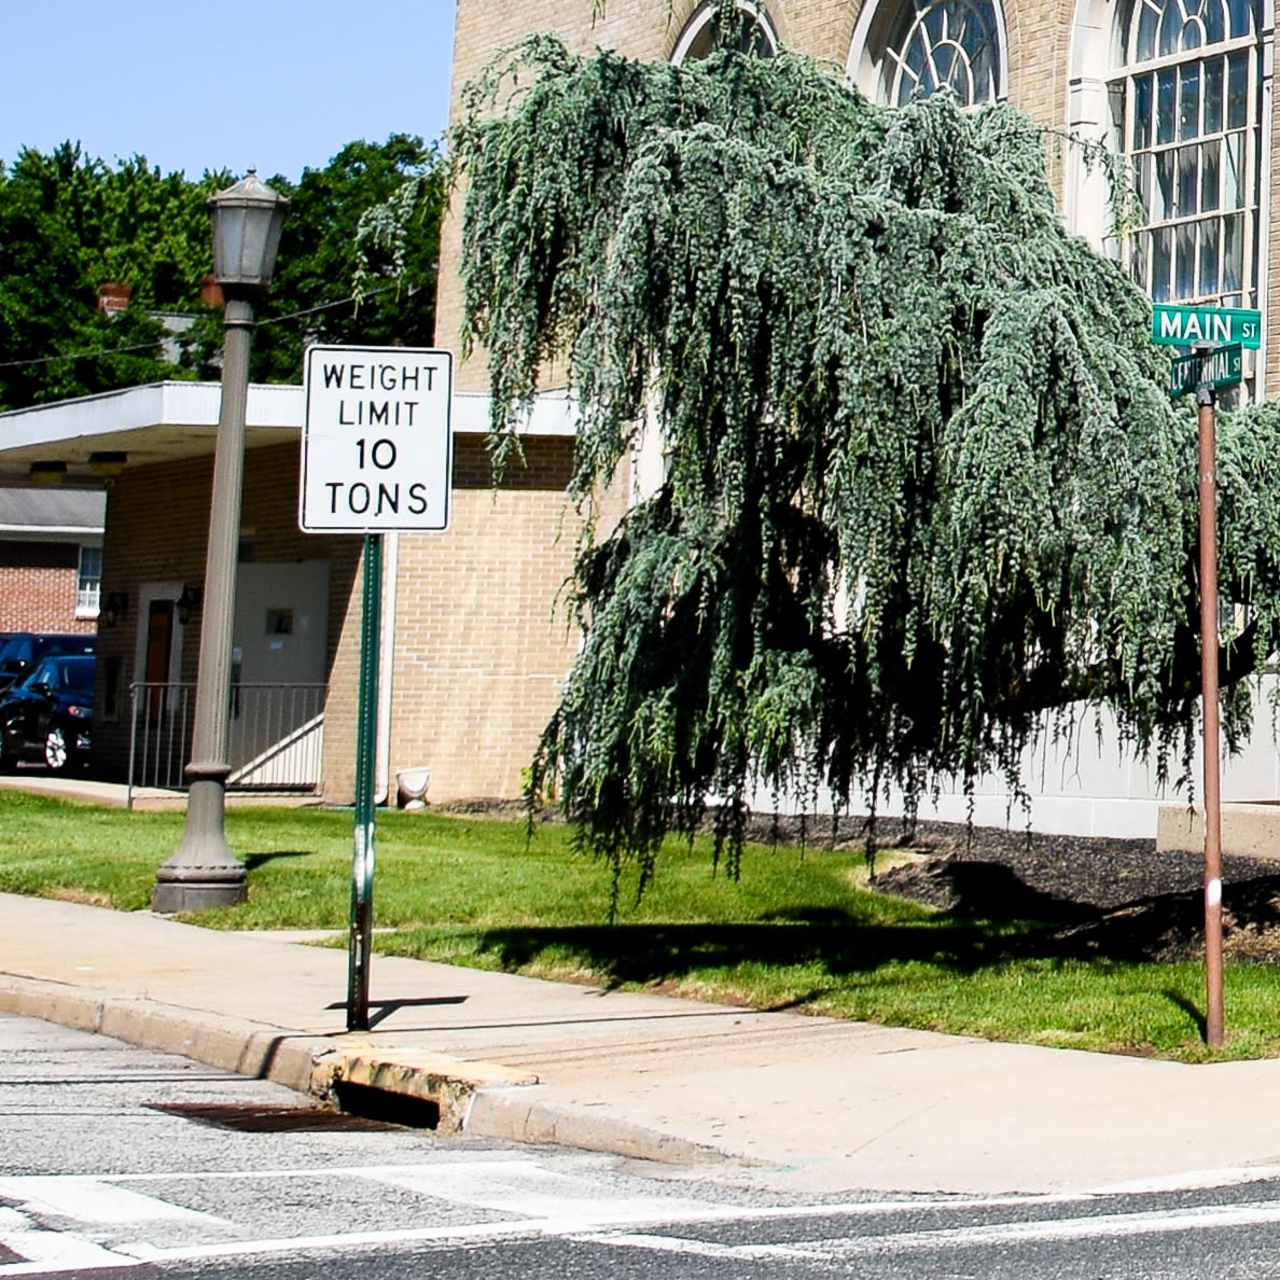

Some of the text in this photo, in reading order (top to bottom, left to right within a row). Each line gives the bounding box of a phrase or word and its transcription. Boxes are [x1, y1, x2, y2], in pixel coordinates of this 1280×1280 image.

[1160, 311, 1256, 342] MAIN ST
[323, 364, 438, 391] WEIGHT
[339, 400, 419, 426] LIMIT
[356, 438, 397, 470] 10
[325, 482, 428, 516] TONS
